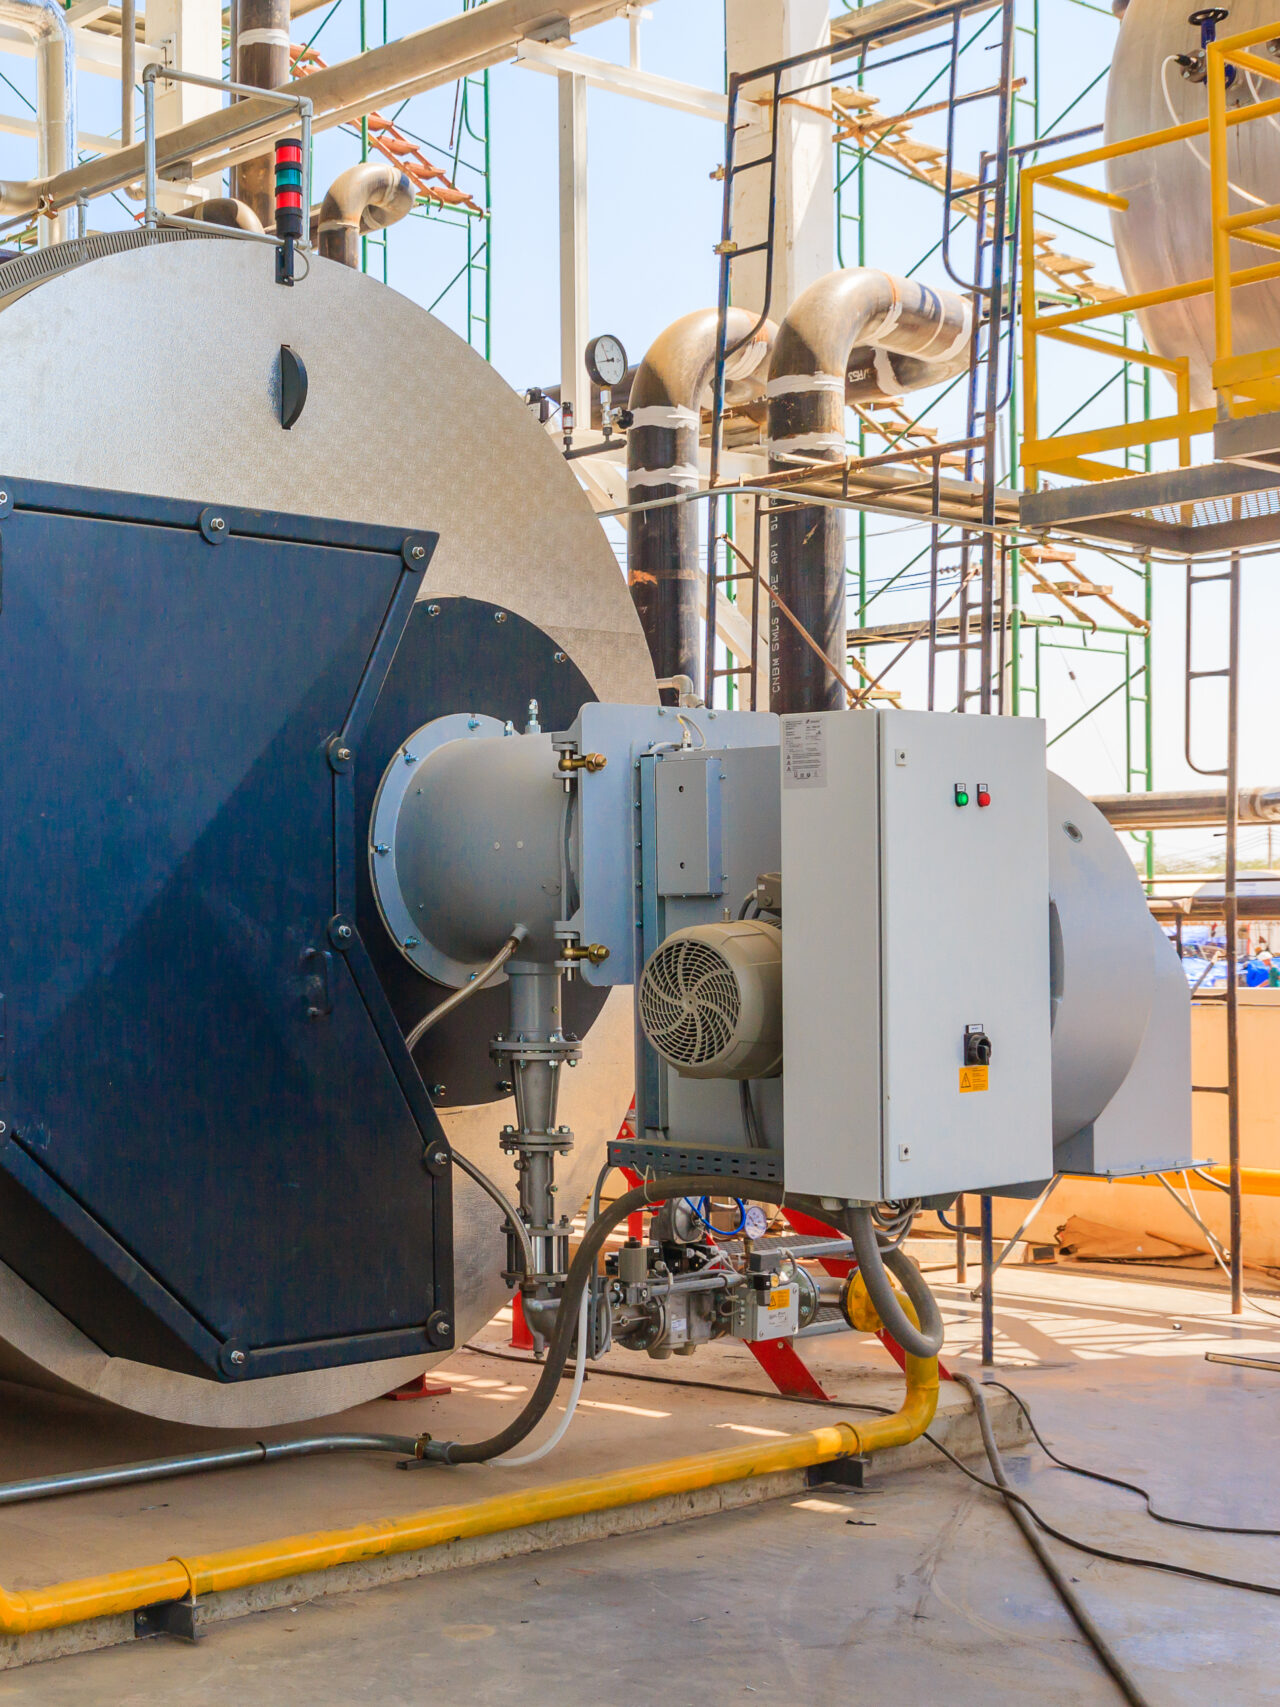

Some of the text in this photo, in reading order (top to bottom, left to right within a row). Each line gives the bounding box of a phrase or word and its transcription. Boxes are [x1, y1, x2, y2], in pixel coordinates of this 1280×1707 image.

[770, 544, 780, 564] API
[770, 574, 780, 608] PPE
[771, 656, 781, 693] CNBM
